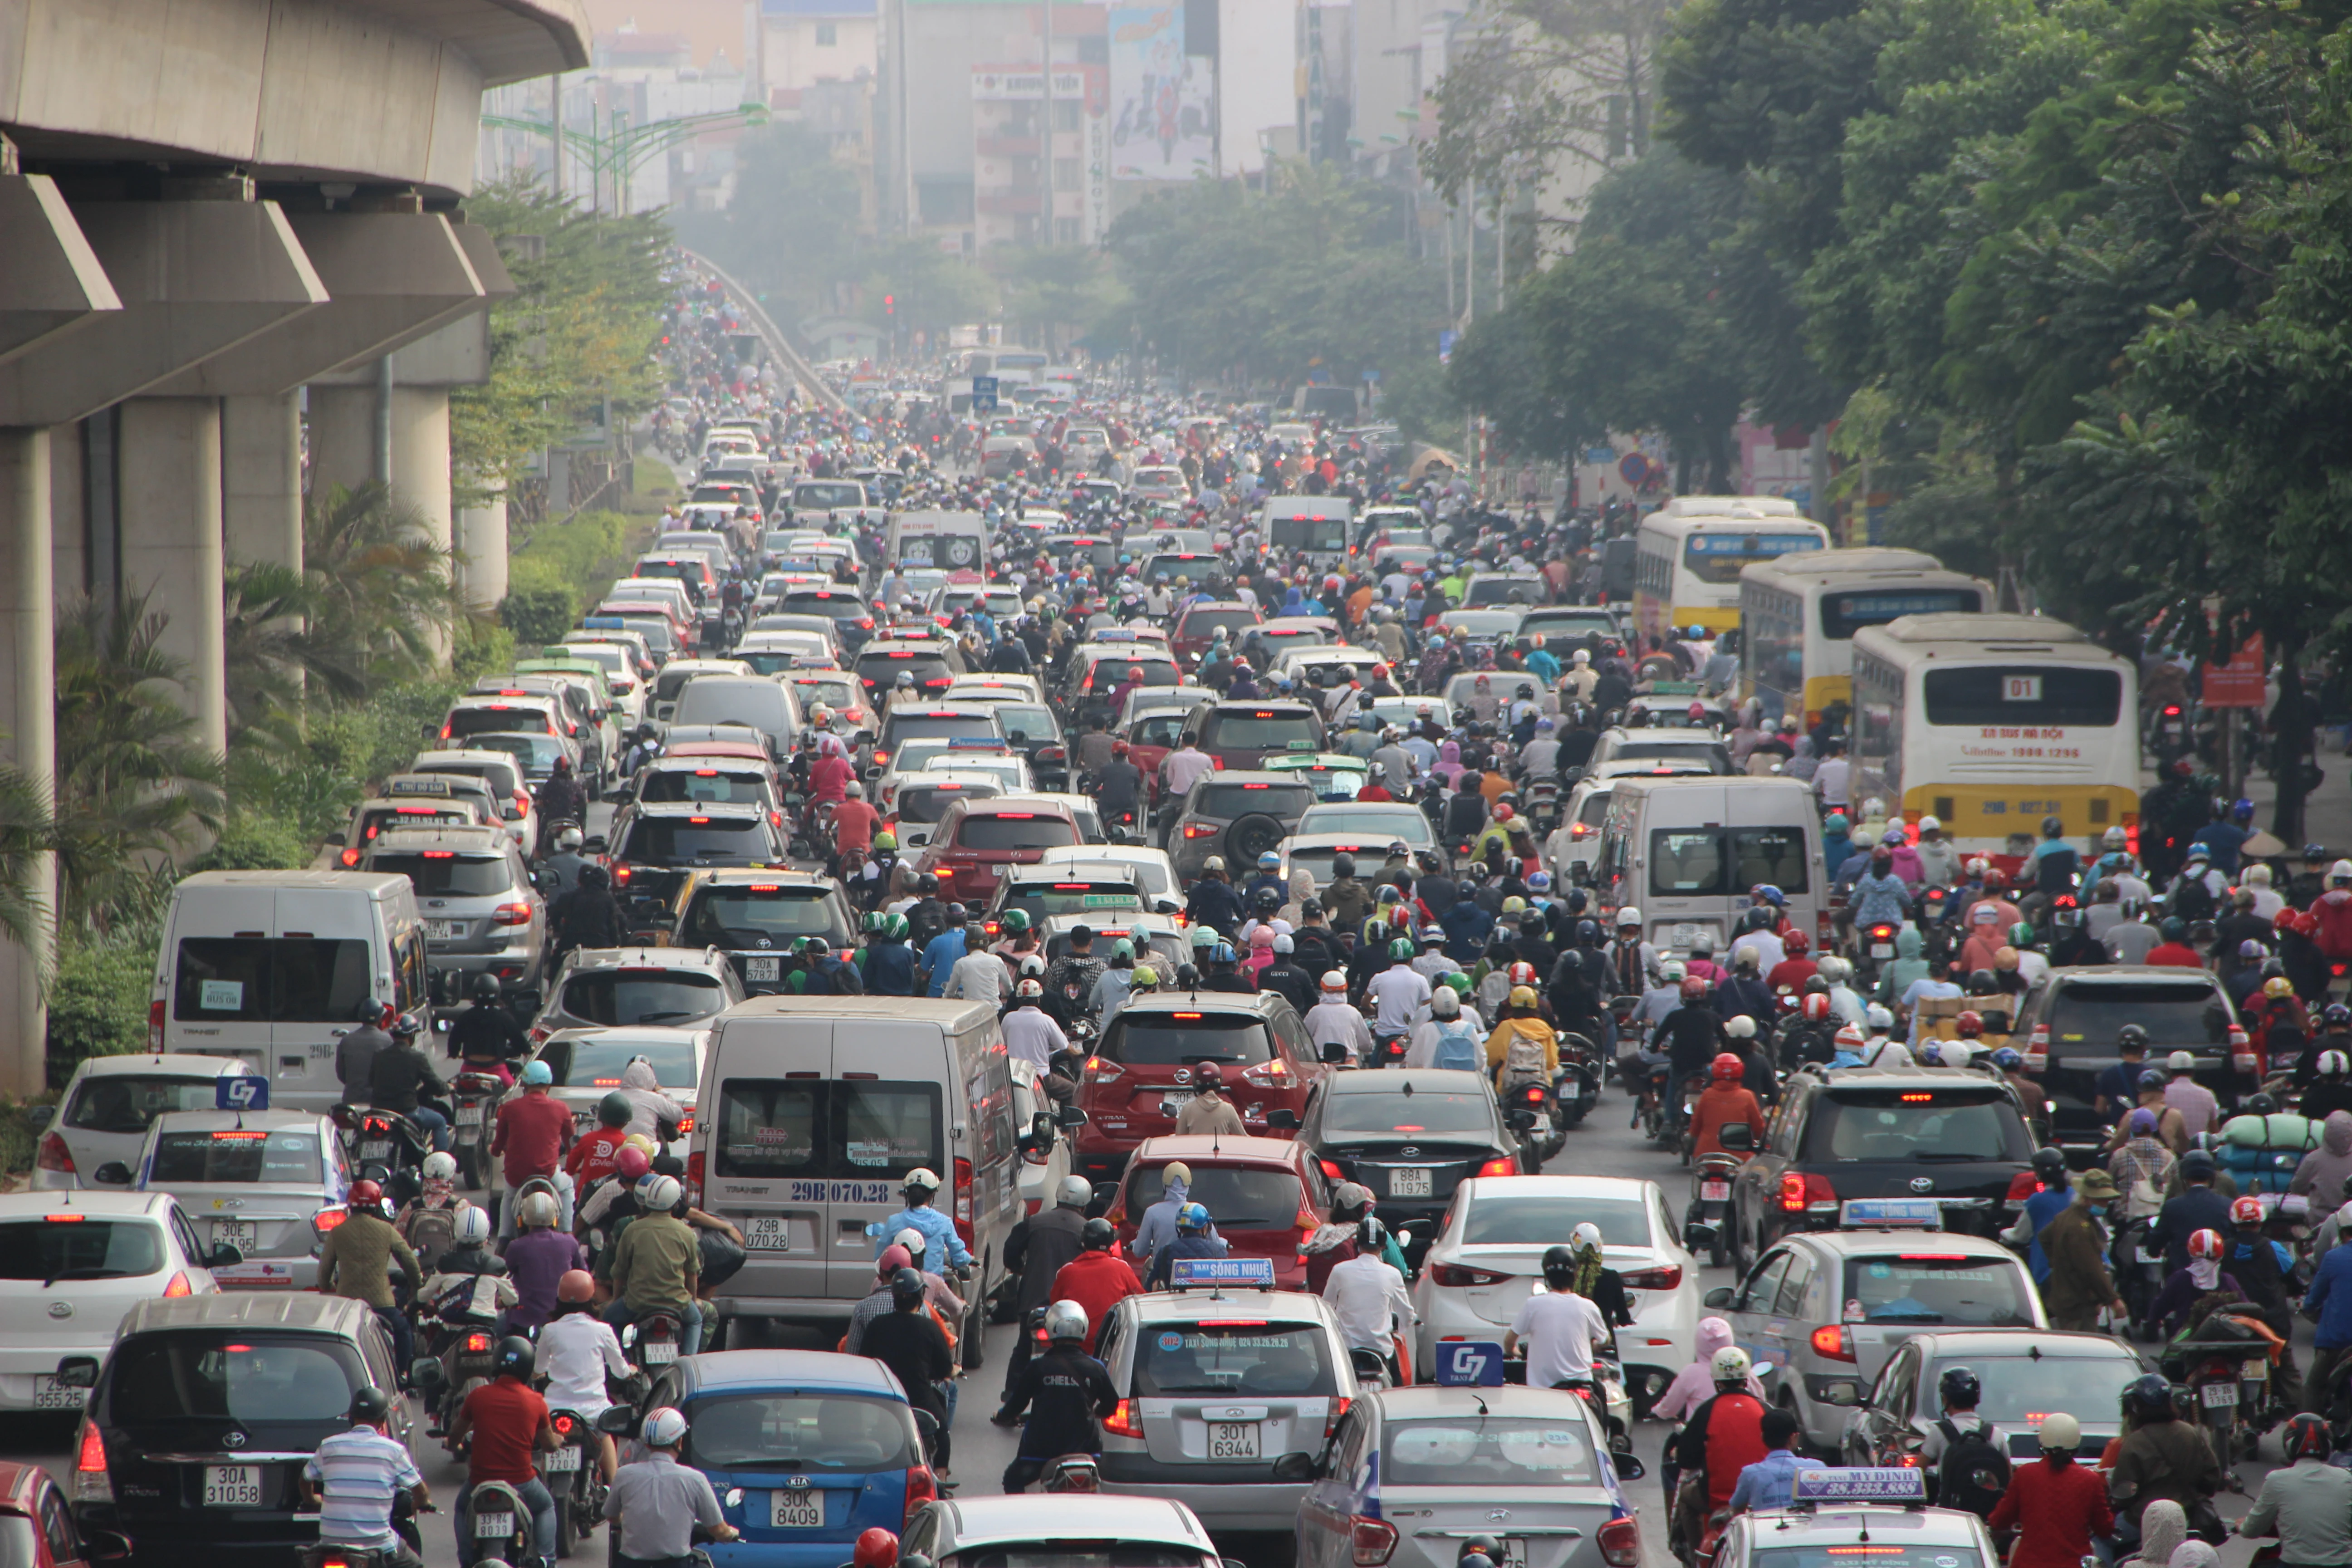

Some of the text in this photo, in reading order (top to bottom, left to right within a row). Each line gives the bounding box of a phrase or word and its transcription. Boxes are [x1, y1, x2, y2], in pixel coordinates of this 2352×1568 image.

[2011, 680, 2030, 697] 01
[2000, 728, 2019, 739] BUS
[755, 959, 772, 969] 30A
[747, 970, 778, 980] 578.71
[229, 1079, 257, 1106] G7
[1400, 1170, 1421, 1181] 88A
[791, 1181, 888, 1202] 29B 070.28
[1394, 1182, 1429, 1194] 119.75
[222, 1223, 245, 1237] 30E
[756, 1220, 779, 1233] 29B
[746, 1234, 787, 1247] 070.28
[1210, 1261, 1239, 1277] SÔNG
[1241, 1261, 1270, 1278] NHUỆ
[1163, 1337, 1181, 1347] 302
[1185, 1338, 1200, 1348] TAXI
[1239, 1338, 1251, 1347] 024
[1252, 1338, 1289, 1348] 33.26.26.26
[1452, 1347, 1487, 1382] G7
[1450, 1374, 1469, 1382] TAXI
[1220, 1424, 1248, 1440] 30T
[1215, 1441, 1254, 1457] 6344
[219, 1467, 247, 1484] 30A
[790, 1478, 807, 1487] KIA
[1827, 1482, 1918, 1494] 38.333.888
[207, 1485, 258, 1502] 310.58
[783, 1490, 812, 1508] 30K
[777, 1508, 818, 1525] 8409
[481, 1525, 507, 1536] 8039
